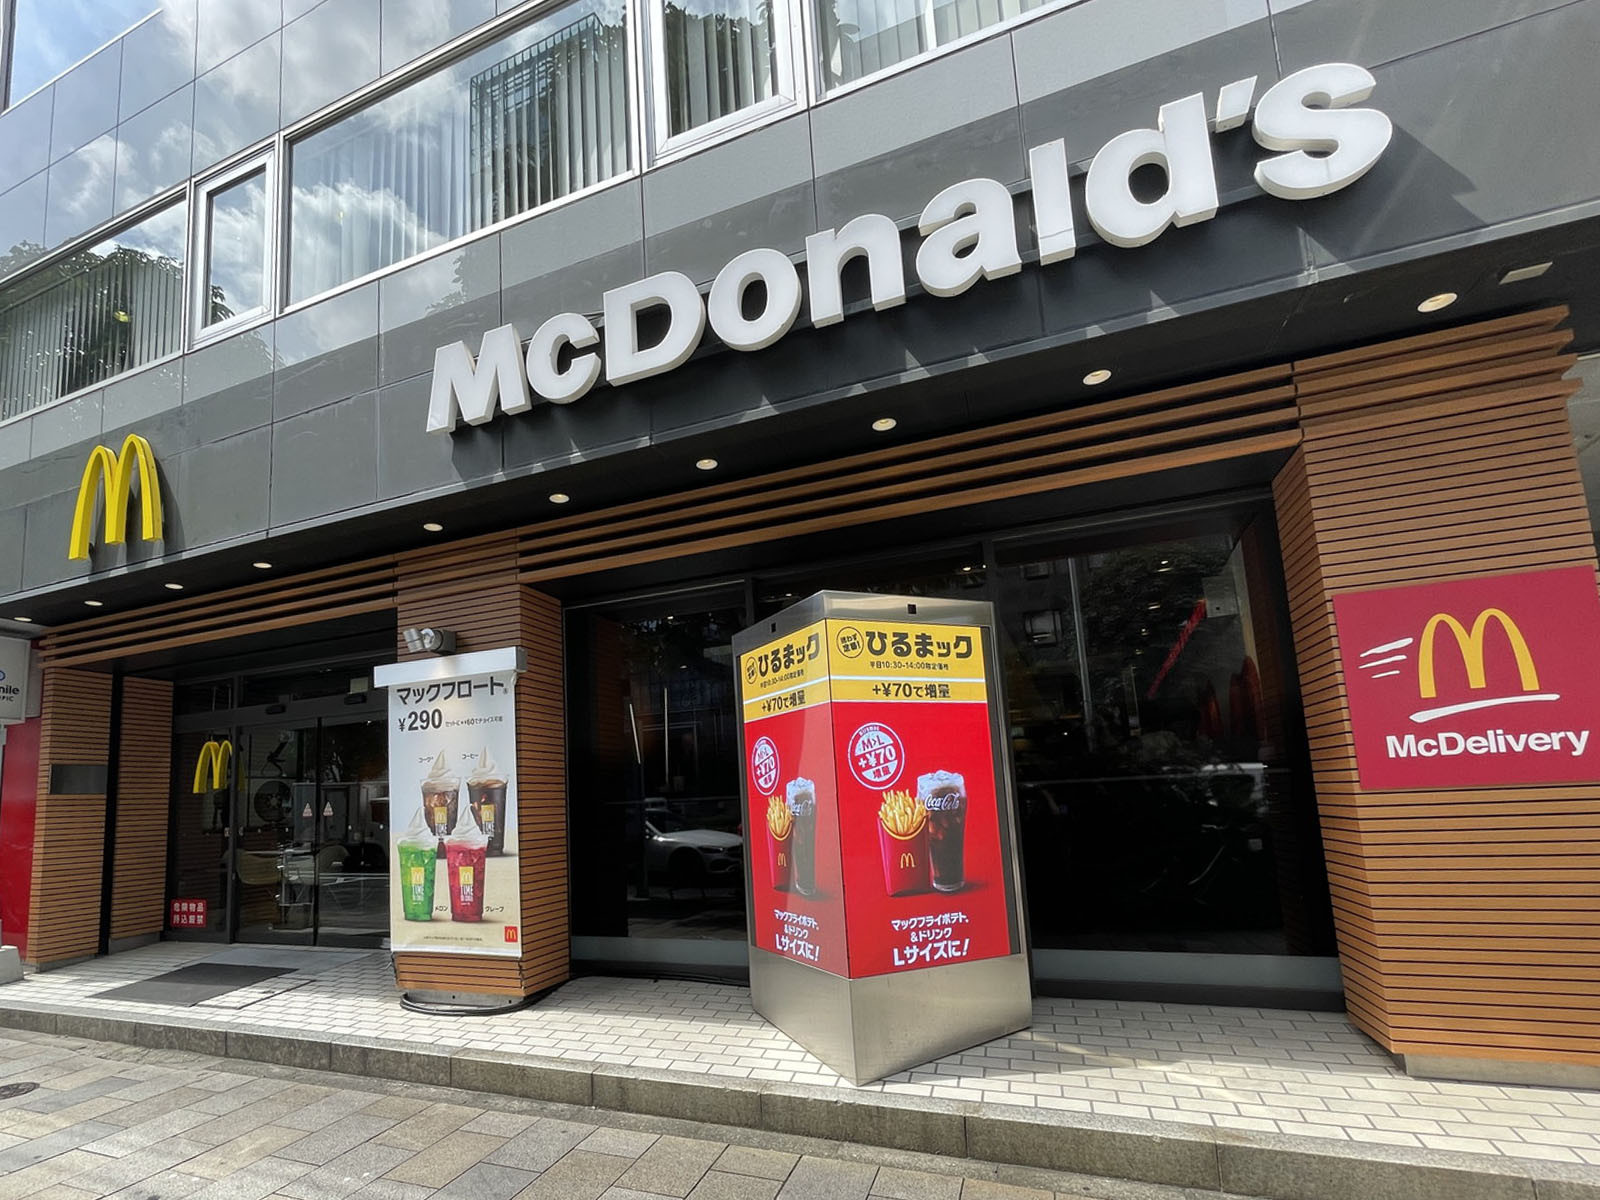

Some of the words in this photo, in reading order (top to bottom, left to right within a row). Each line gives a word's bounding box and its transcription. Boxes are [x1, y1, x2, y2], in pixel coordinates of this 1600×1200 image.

[426, 62, 1393, 436] McDonald's
[757, 632, 820, 677] ひるまック
[865, 630, 973, 659] ひるまック
[872, 682, 951, 698] +¥70で増量
[398, 708, 443, 732] ¥290
[857, 745, 897, 769] +¥70
[1385, 729, 1590, 758] McDelivery
[775, 933, 820, 961] Lサイズに!
[910, 927, 953, 943] &ドリンク
[893, 938, 970, 967] Lサイズに!
